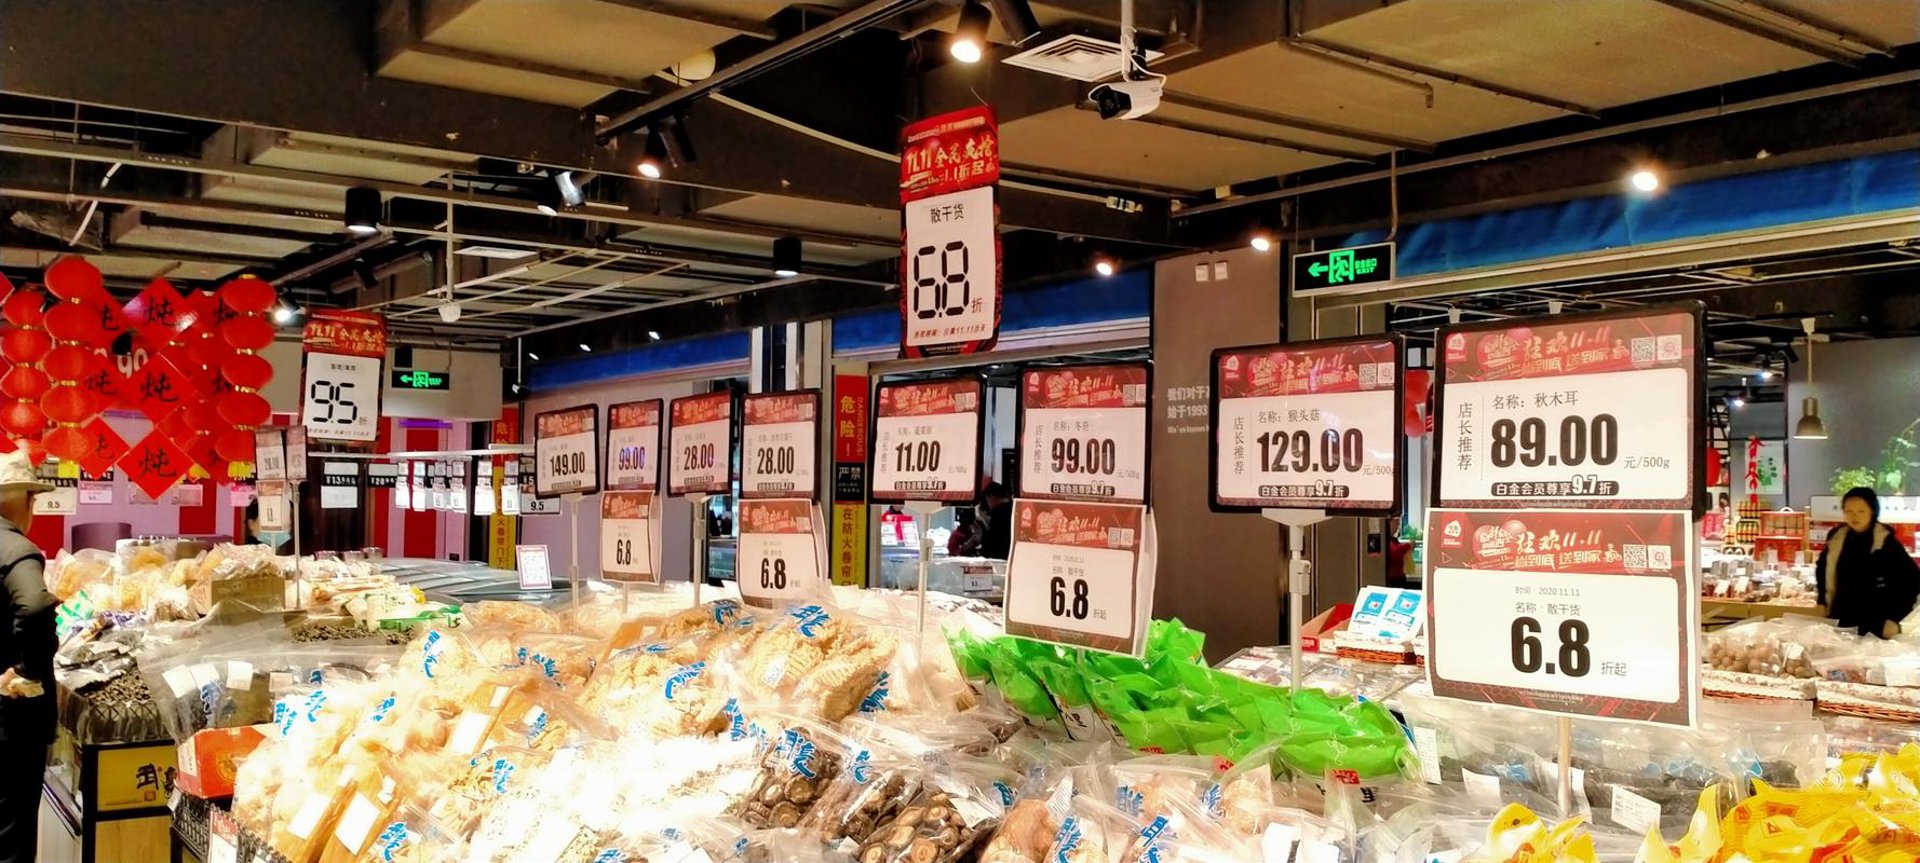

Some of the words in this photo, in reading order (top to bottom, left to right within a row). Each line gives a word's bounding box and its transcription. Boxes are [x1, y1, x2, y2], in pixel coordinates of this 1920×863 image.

[930, 203, 964, 223] 散干货
[913, 241, 970, 320] 6.8
[971, 298, 983, 314] 折
[1234, 416, 1245, 475] 店长推荐
[1256, 427, 1364, 473] 129.00
[1457, 402, 1473, 471] 店长推荐
[1491, 413, 1619, 468] 89.00
[550, 451, 585, 477] 149.00
[619, 446, 645, 471] 99.00
[684, 442, 714, 471] 28.00
[757, 446, 794, 475] 28.00
[895, 440, 941, 472] 11.00
[1051, 438, 1115, 475] 99.00
[1623, 455, 1671, 470] 元/500g
[1496, 475, 1612, 495] 白金会员尊享9.7折
[530, 502, 545, 511] 9.5
[616, 539, 631, 566] 6.8
[761, 558, 786, 590] 6.8
[1050, 576, 1089, 620] 6.8
[1511, 616, 1591, 678] 6.8
[1601, 661, 1627, 677] 折起
